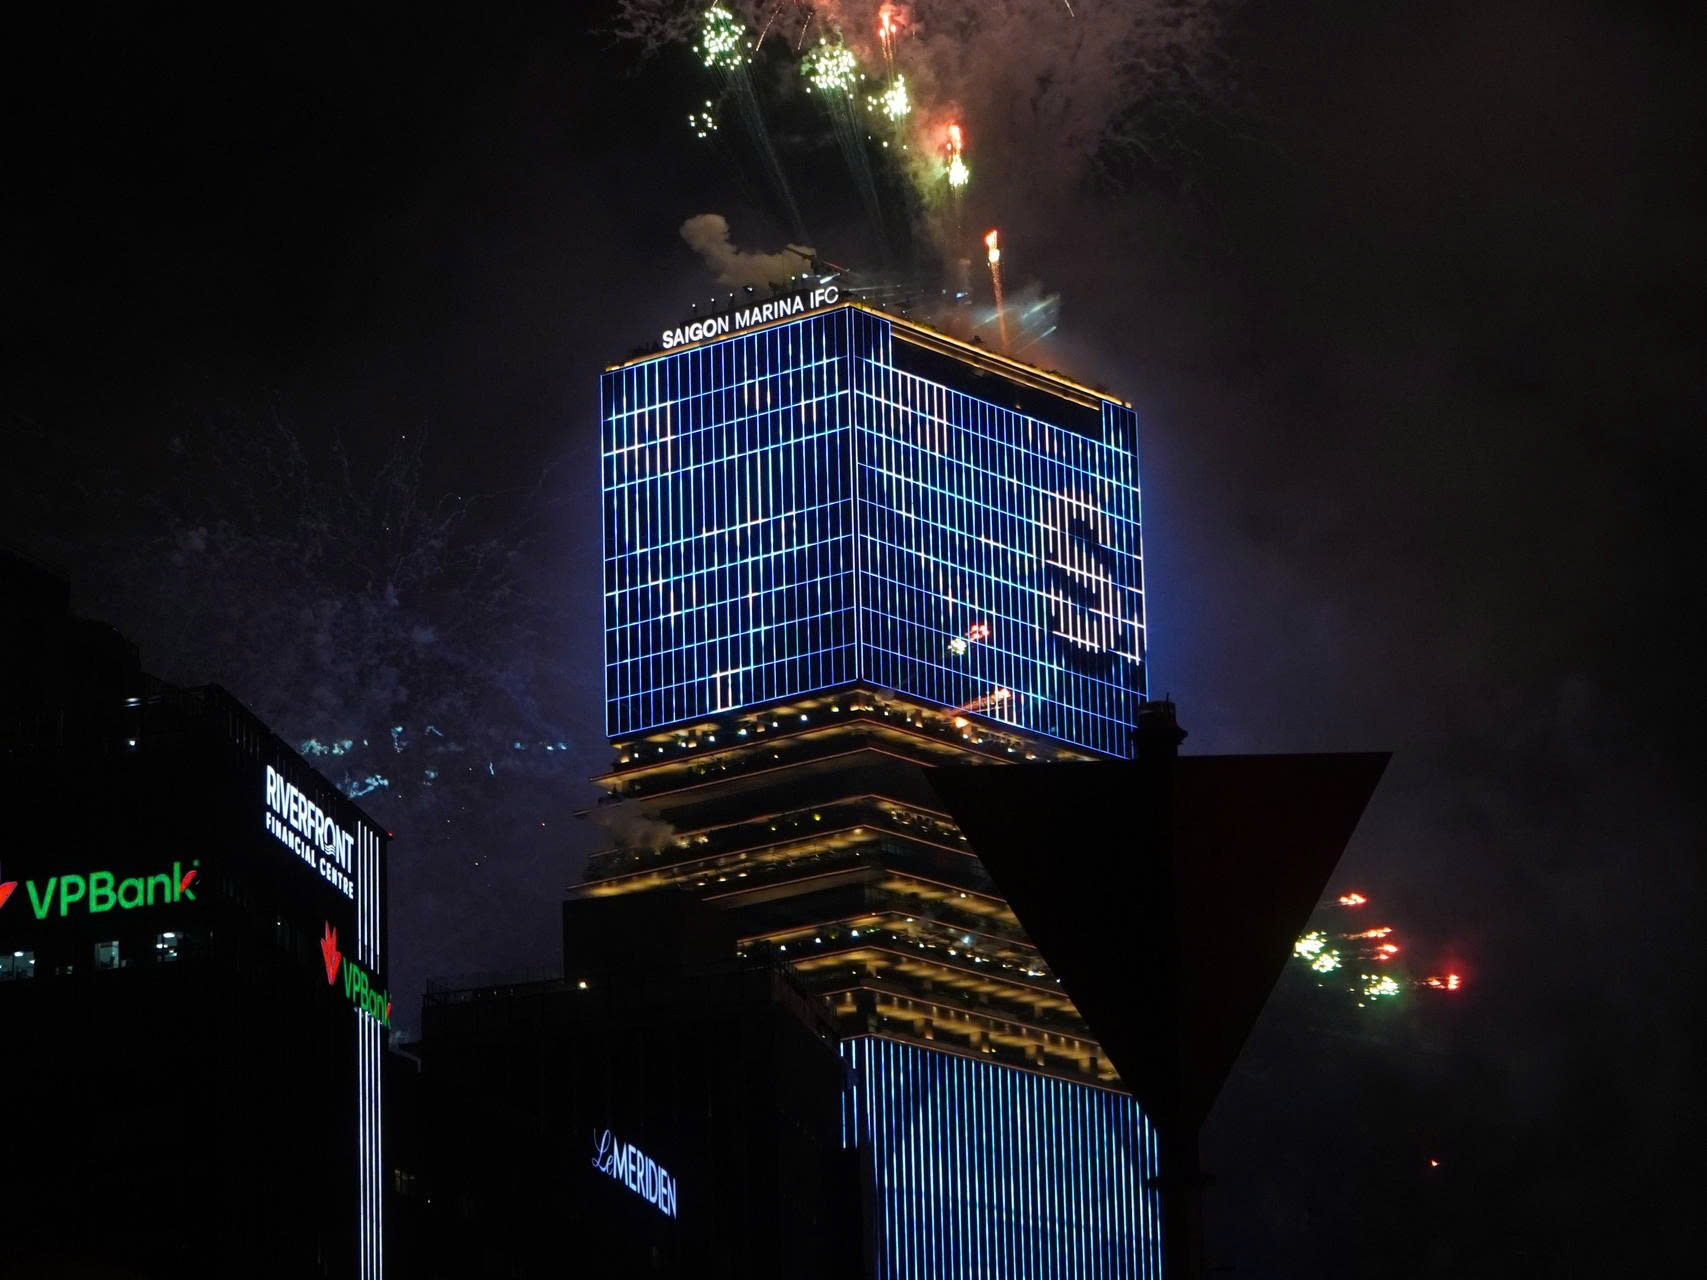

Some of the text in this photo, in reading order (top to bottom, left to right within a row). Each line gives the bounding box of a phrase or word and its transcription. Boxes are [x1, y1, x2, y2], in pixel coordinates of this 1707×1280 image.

[662, 286, 840, 349] SAIGON MARINA IFC
[265, 811, 354, 900] FINANCIAL CENTRE
[266, 764, 355, 874] RIVERFRONT
[25, 860, 198, 920] VPBank
[343, 956, 393, 1030] VPBank
